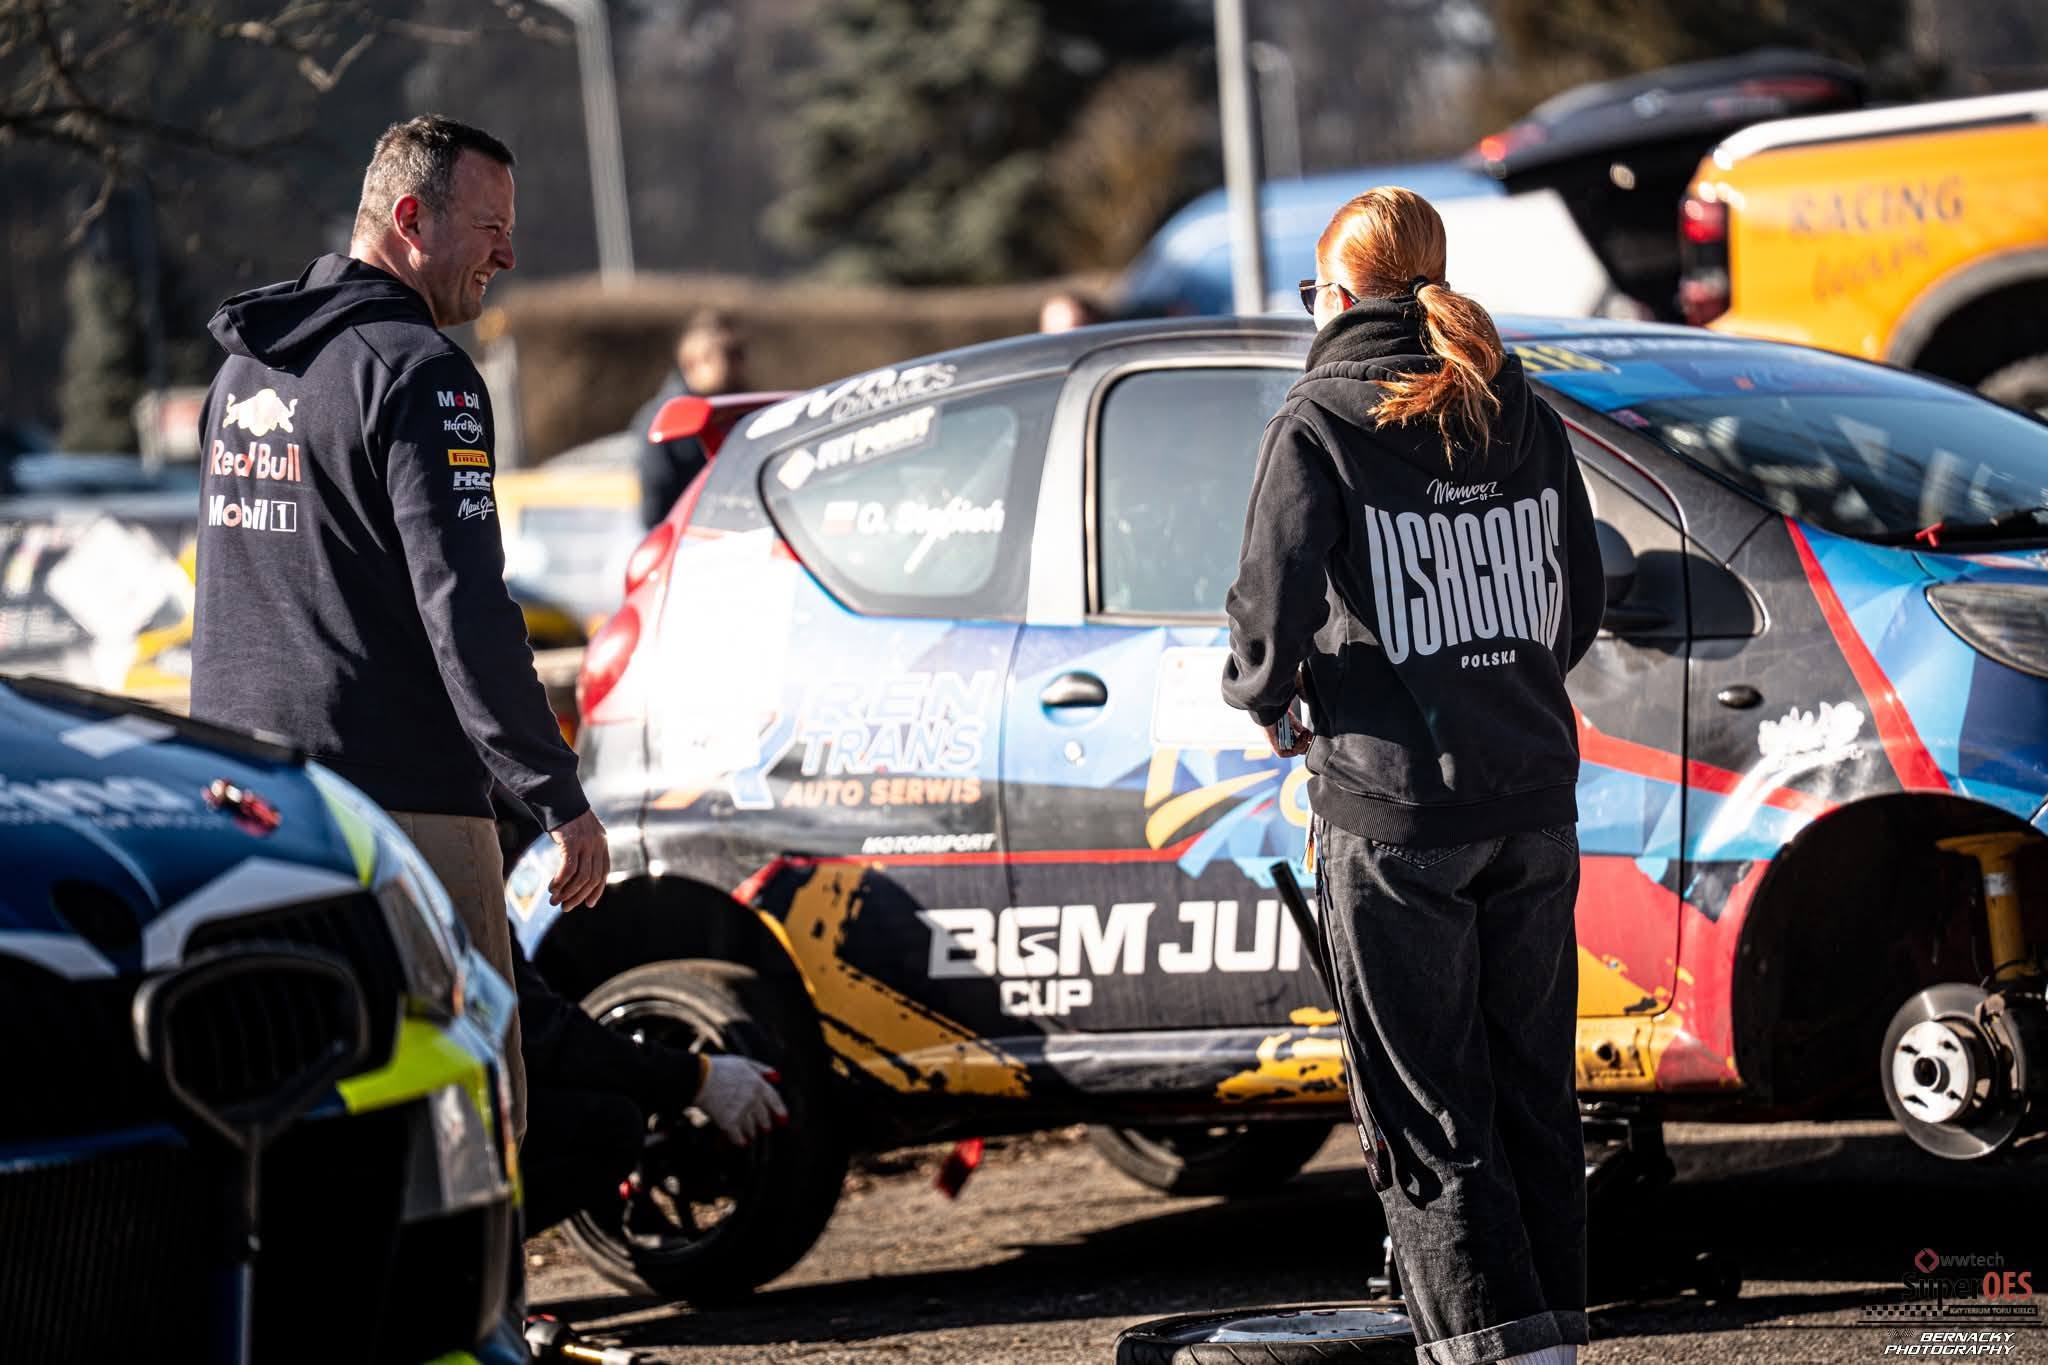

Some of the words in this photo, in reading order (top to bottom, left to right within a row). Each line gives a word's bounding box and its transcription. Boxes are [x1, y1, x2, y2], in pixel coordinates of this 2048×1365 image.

[1790, 176, 1964, 233] RACING
[437, 391, 480, 409] Mobil
[443, 420, 467, 431] Hard
[210, 440, 257, 478] Red
[256, 443, 301, 482] Bull
[453, 452, 487, 464] PIRELLI
[453, 471, 491, 487] HRC
[208, 495, 268, 531] Mobil
[1364, 488, 1564, 665] USACARS
[1461, 650, 1516, 669] POLSKA
[801, 719, 986, 776] TRANS
[782, 780, 865, 808] AUTO
[870, 777, 982, 806] SERWIS
[862, 834, 997, 854] MOTORSPORT
[915, 902, 1156, 978] BGM
[1001, 978, 1093, 1016] CUP
